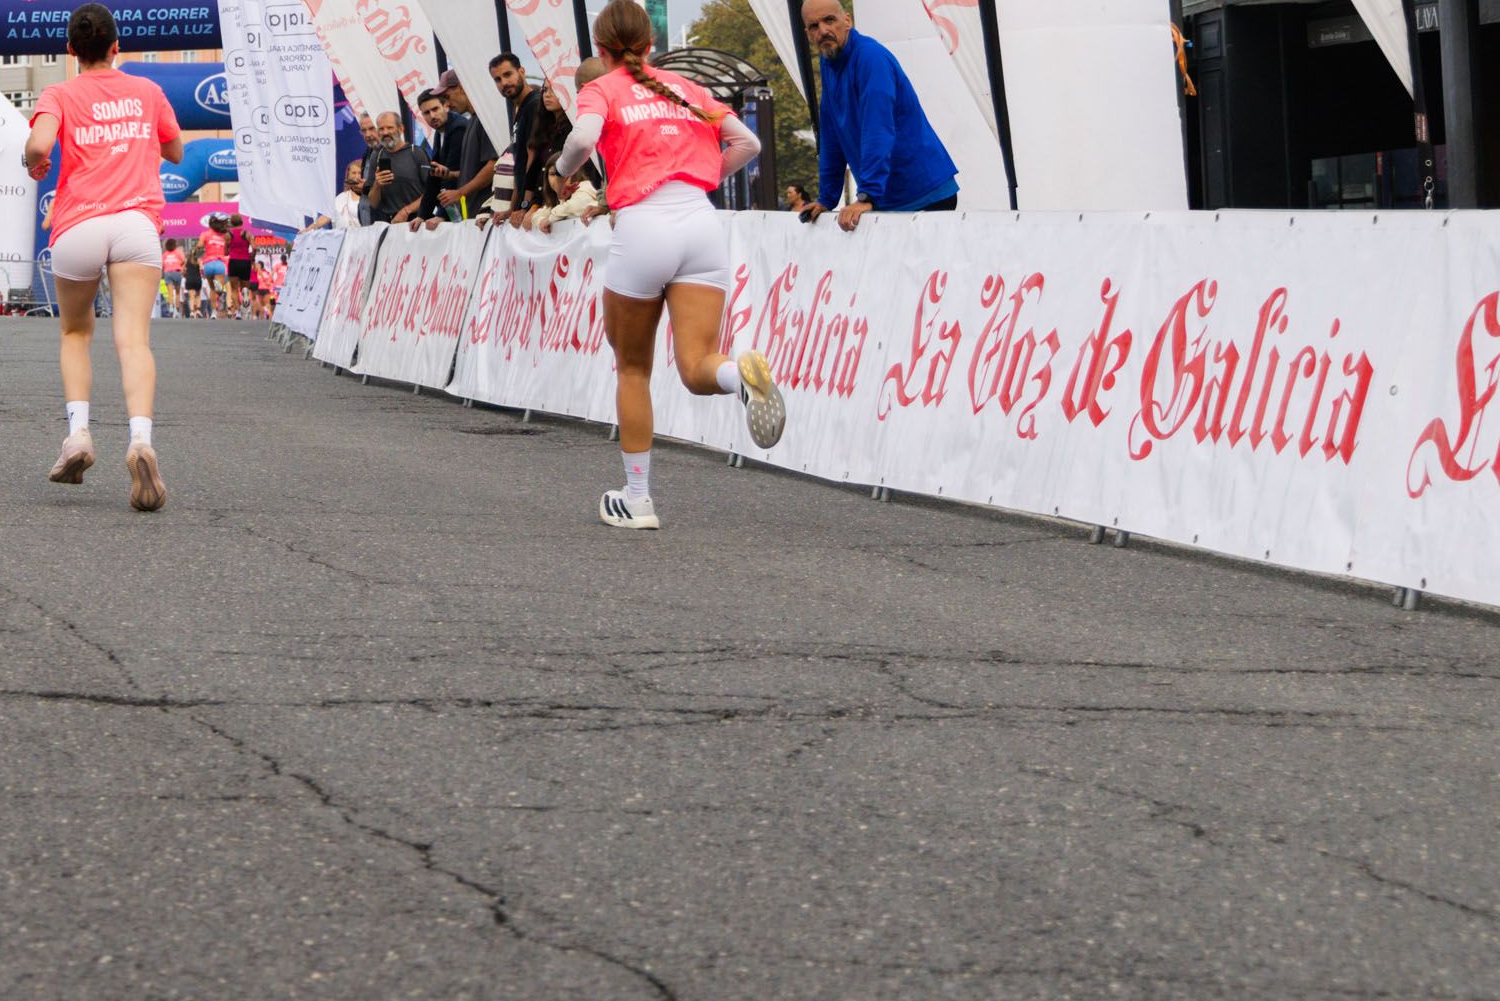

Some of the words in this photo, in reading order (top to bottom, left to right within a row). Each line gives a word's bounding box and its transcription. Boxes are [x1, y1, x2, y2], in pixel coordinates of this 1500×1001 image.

[7, 10, 27, 24] LA
[113, 9, 143, 22] ARA
[147, 7, 210, 21] CORRER
[1414, 6, 1438, 30] LAYA
[7, 27, 18, 39] A
[22, 27, 41, 39] LA
[136, 25, 156, 36] DE
[161, 24, 179, 35] LA
[184, 23, 213, 35] LUZ
[92, 98, 143, 121] SOMOS
[752, 262, 869, 400] Galicia
[877, 269, 962, 421] La
[968, 271, 1061, 440] Voz
[1060, 276, 1133, 428] de
[1127, 277, 1375, 466] Galicia
